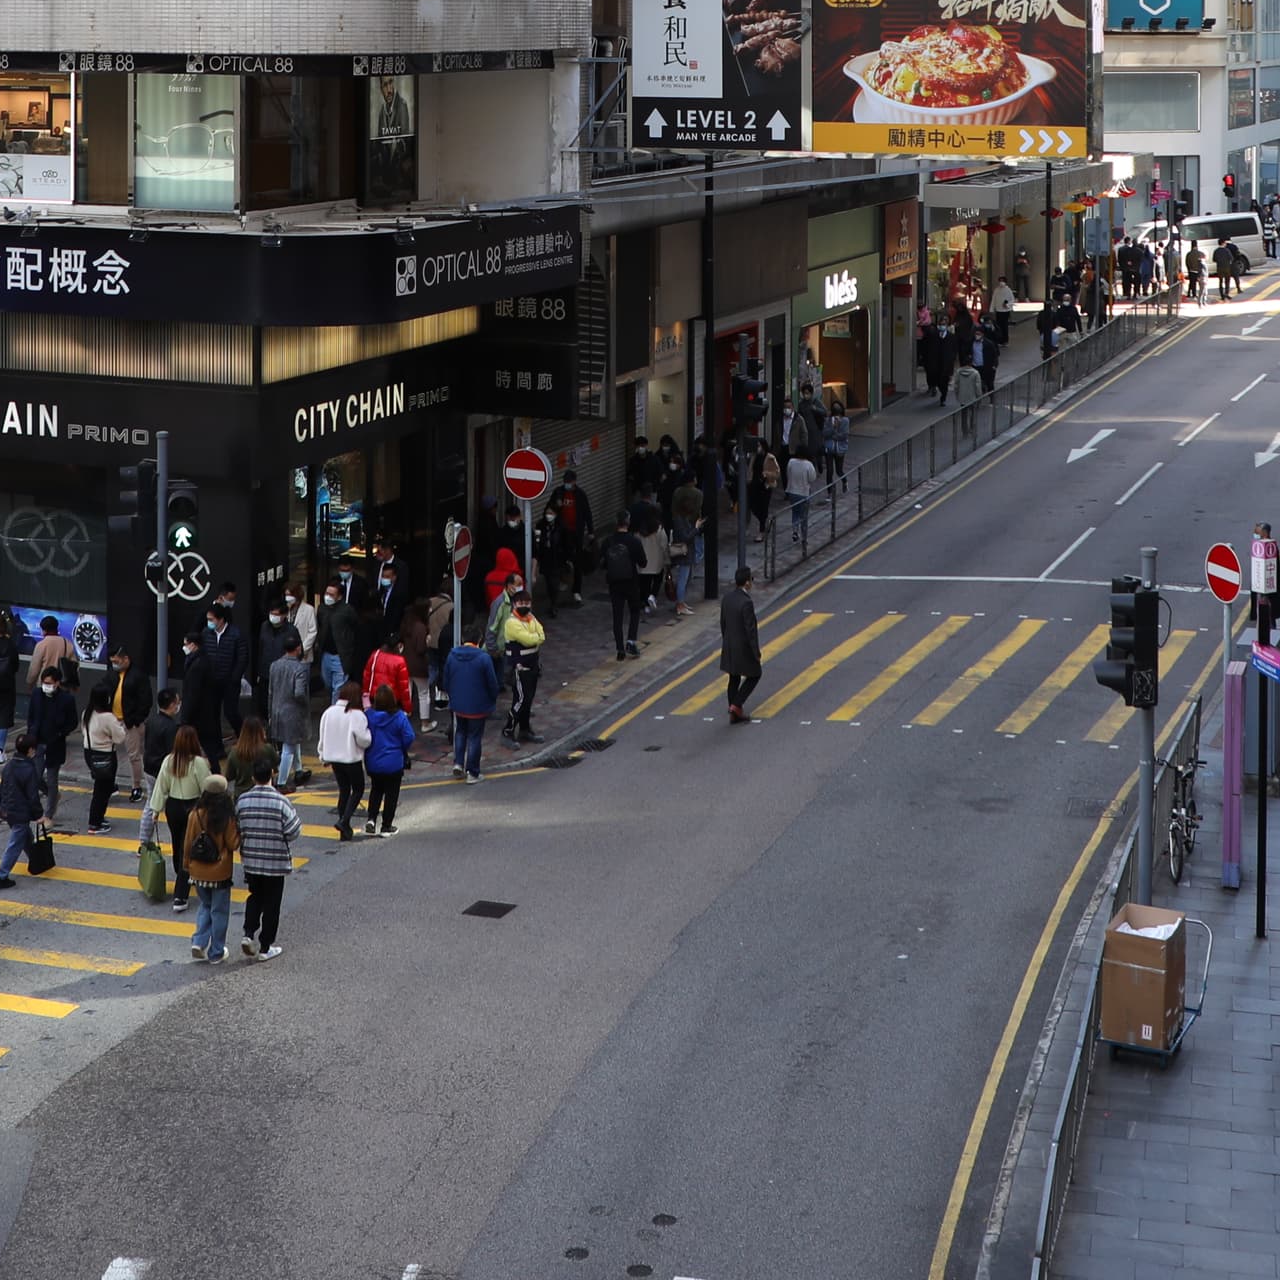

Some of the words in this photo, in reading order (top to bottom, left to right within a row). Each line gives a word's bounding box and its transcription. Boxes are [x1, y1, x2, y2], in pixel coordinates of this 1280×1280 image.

[209, 56, 274, 73] OPTICAL
[275, 56, 294, 73] 88
[443, 53, 472, 70] OPTICAL
[472, 53, 483, 69] 88
[676, 109, 736, 129] LEVEL
[744, 110, 756, 129] 2
[676, 132, 698, 141] MAN
[701, 132, 717, 142] YEE
[719, 133, 757, 142] ARCADE
[887, 128, 1006, 150] 勵精中心一樓
[422, 249, 484, 287] OPTICAL
[485, 245, 502, 274] 88
[504, 261, 540, 276] PROGRESSIVE
[539, 258, 553, 270] LENS
[553, 254, 574, 267] CENTRE
[825, 270, 858, 310] bless
[495, 369, 554, 392] 時間廊
[294, 398, 341, 443] CITY
[345, 382, 405, 429] CHAIN
[408, 385, 449, 411] PRIMO
[67, 423, 150, 446] PRIMO
